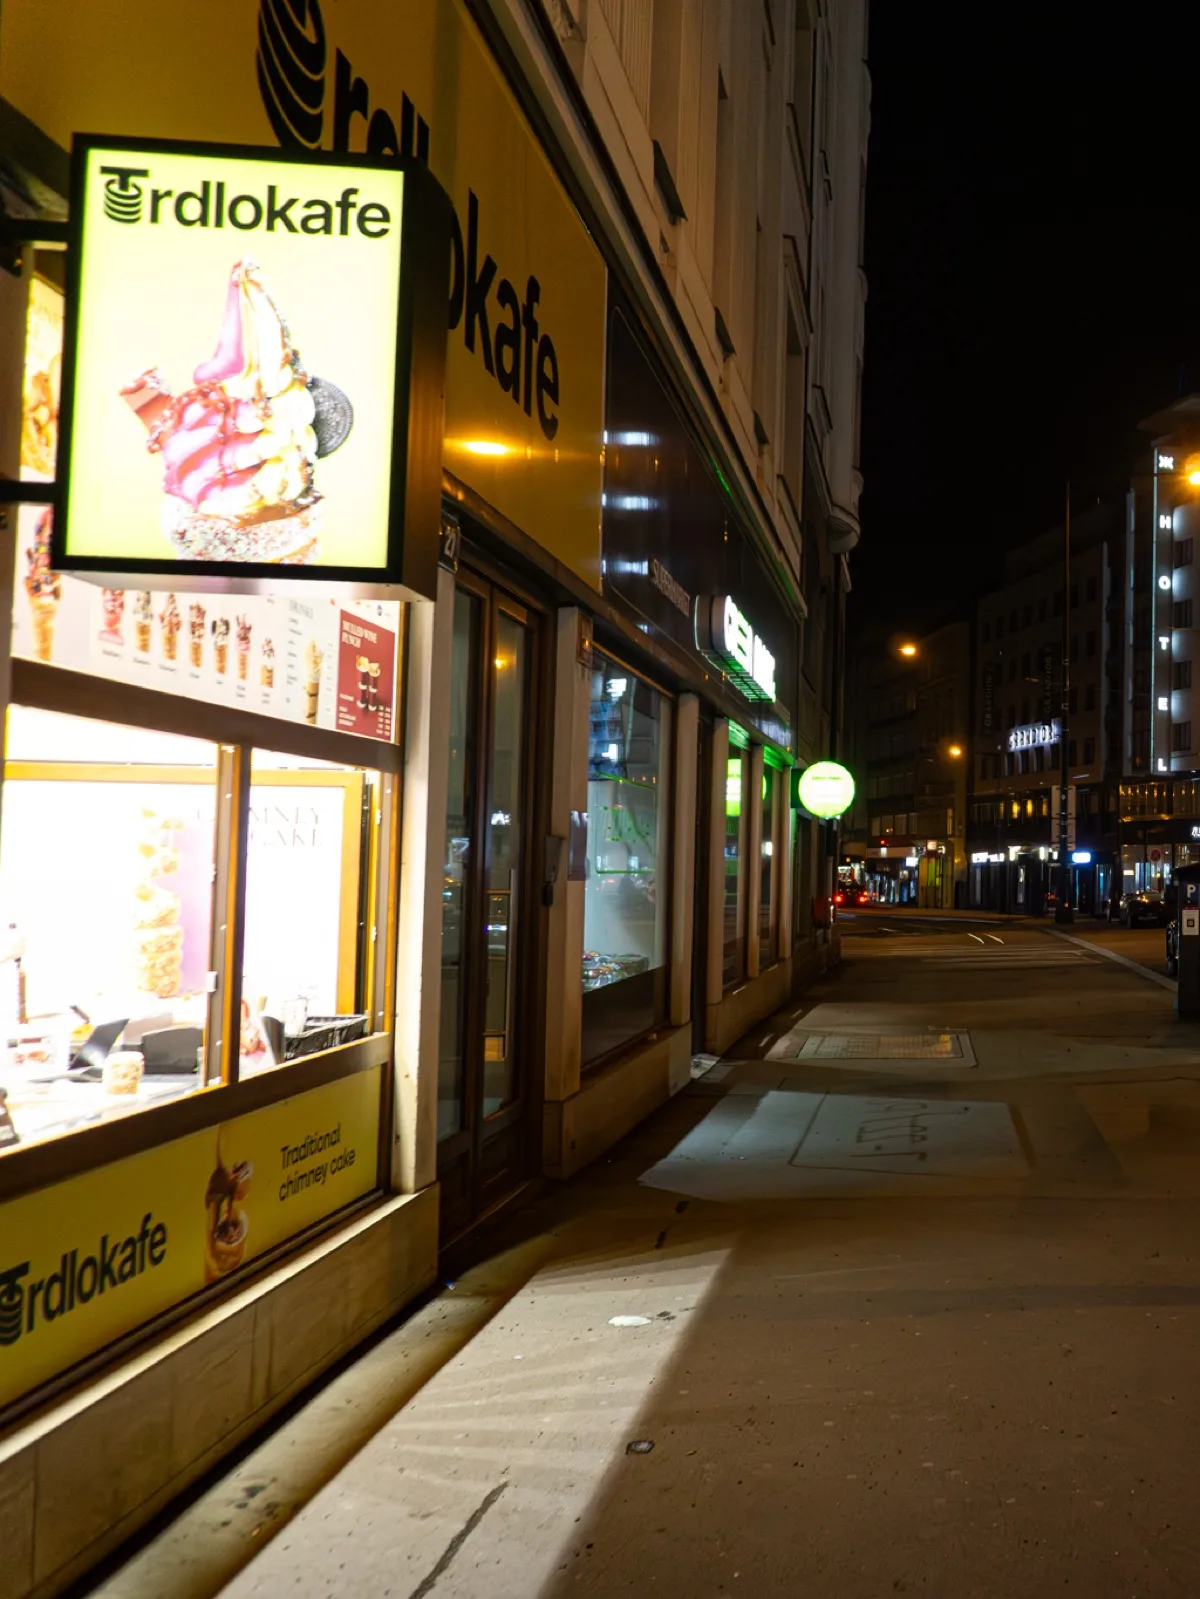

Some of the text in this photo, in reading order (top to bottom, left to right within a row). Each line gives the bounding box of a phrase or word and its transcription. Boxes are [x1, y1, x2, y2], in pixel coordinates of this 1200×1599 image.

[100, 165, 391, 239] Trdlokafe
[1186, 883, 1196, 899] P
[280, 1122, 342, 1170] Traditional
[278, 1147, 357, 1203] chimney cake
